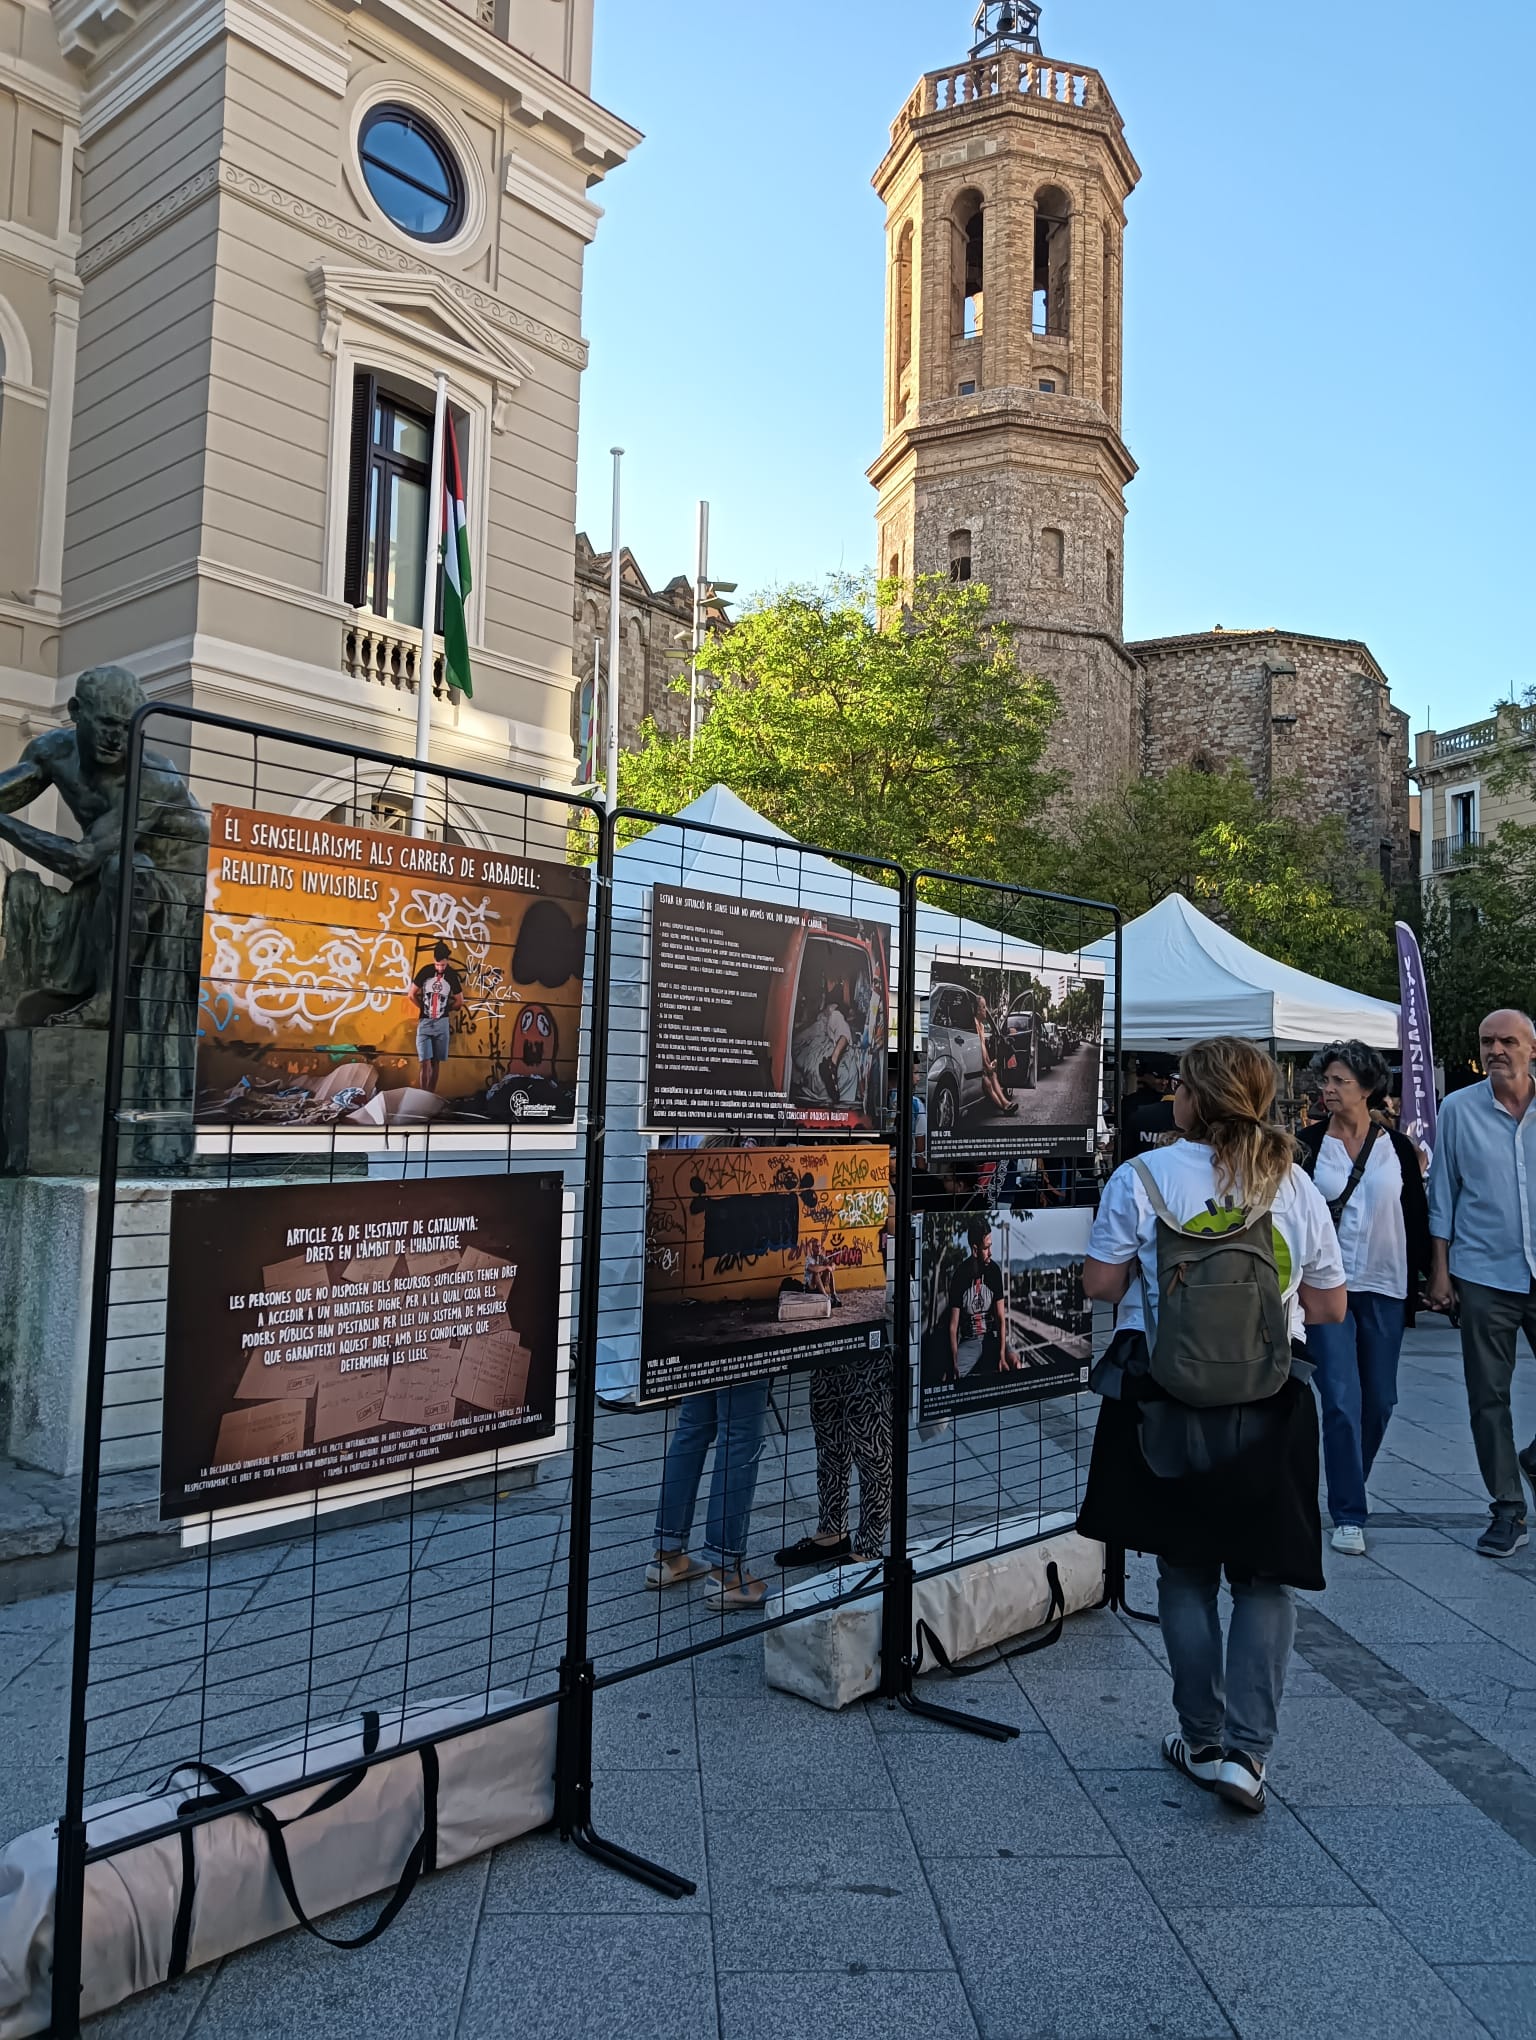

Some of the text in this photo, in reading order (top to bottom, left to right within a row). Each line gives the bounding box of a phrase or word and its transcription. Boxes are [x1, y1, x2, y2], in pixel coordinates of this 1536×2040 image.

[224, 817, 539, 888] EL SENSELLARISME ALS CARRERS DE SABADELL:
[221, 857, 377, 900] REALITATS INVISIBLES
[659, 893, 674, 905] ESTAR
[684, 896, 705, 910] SITUACIÓ
[706, 901, 712, 911] DE
[729, 905, 739, 915] LLAR
[741, 907, 748, 916] NO
[286, 1216, 478, 1245] ARTICLE 26 DE L'ESTATUT DE CATALUNYA:
[305, 1245, 334, 1262] DRETS
[338, 1244, 351, 1259] EN
[355, 1239, 389, 1258] L'ÀMBIT
[394, 1239, 405, 1254] DE
[229, 1265, 516, 1309] LES PERSONES QUE NO DISPOSEN DELS RECURSOS SUFICIENTS TENEN DRET
[257, 1285, 496, 1326] A ACCEDIR A UN HABITATGE DIGNE, PER A LA QUAL COSA ELS
[241, 1301, 506, 1347] PODERS PÚBLICS HAN D'ESTABLIR PER LLEI UN SISTEMA DE MESURES
[263, 1320, 488, 1364] QUE GARANTEIXI AQUEST DRET, AMB LES CONDICIONS QUE
[340, 1347, 428, 1371] DETERMINEN LES LLEIS.
[199, 1468, 207, 1477] LA
[209, 1461, 241, 1475] DECLARACIÓ
[230, 1474, 237, 1483] EL
